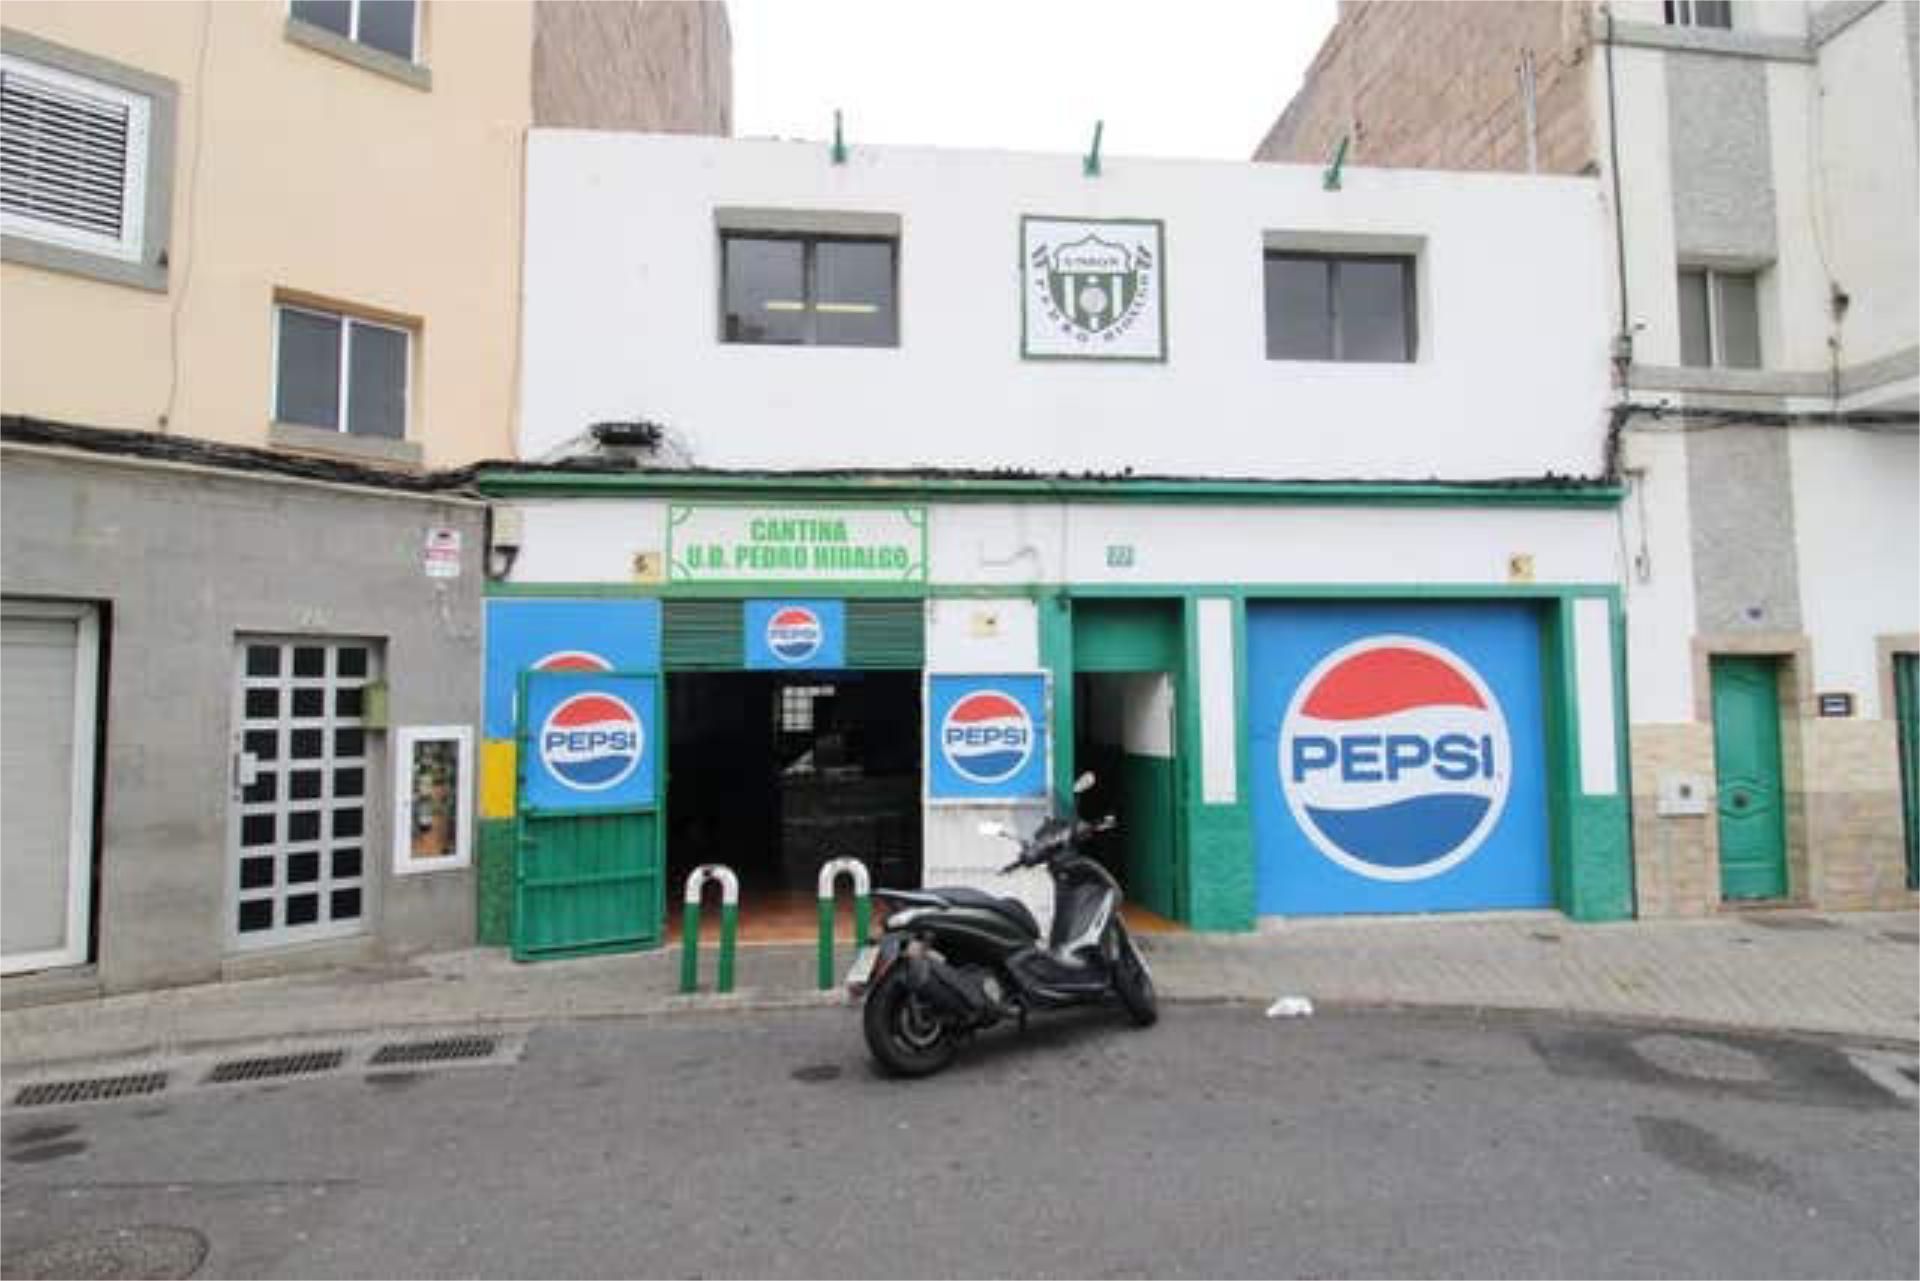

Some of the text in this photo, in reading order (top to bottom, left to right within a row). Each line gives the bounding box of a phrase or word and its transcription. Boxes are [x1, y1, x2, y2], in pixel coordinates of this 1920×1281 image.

[750, 518, 848, 542] CANTINA
[734, 545, 808, 569] PEDRO
[815, 545, 910, 570] HIDALGO
[545, 731, 637, 753] PEPSI
[946, 727, 1027, 746] PEPSI
[1292, 733, 1495, 783] PEPSI
